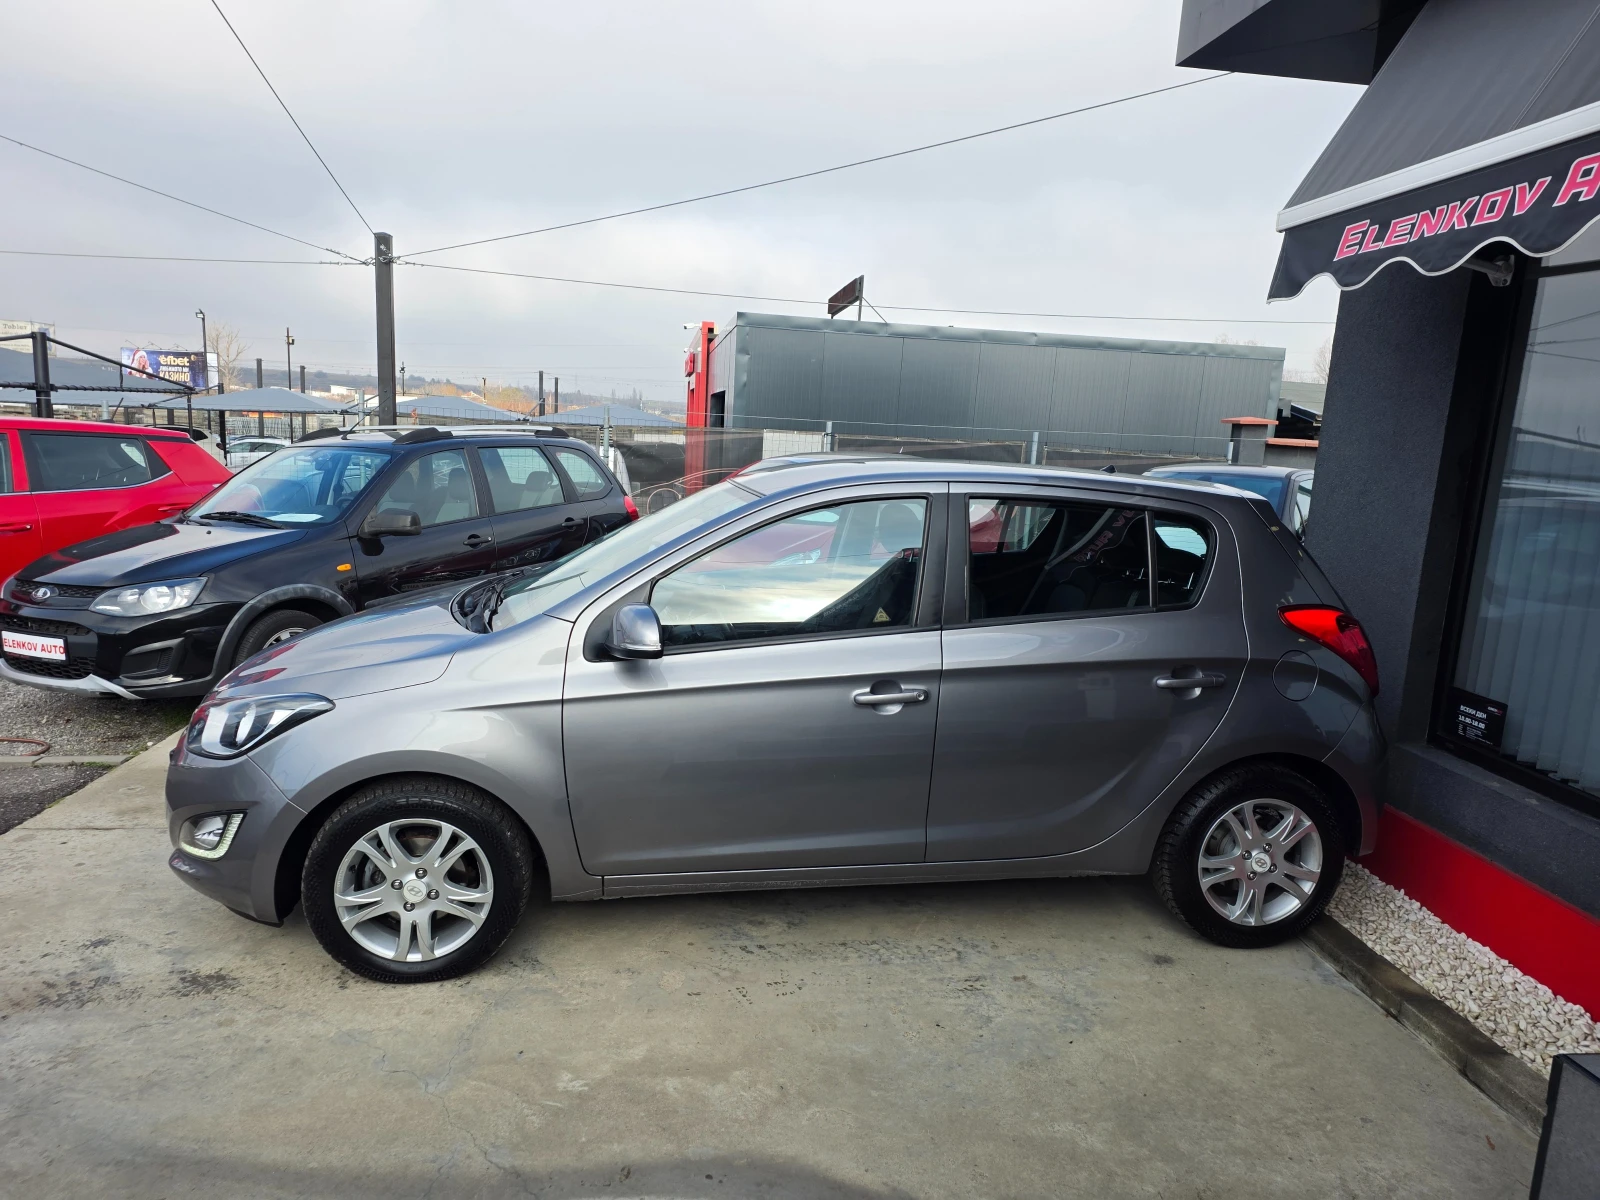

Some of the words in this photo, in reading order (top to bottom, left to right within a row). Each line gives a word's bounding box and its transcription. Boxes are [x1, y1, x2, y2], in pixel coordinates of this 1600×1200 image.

[1333, 176, 1552, 261] ELENKOV
[160, 355, 189, 366] efbet
[160, 371, 190, 382] КАЗИНО
[4, 638, 37, 651] ELENKOV
[41, 644, 66, 654] AUTO
